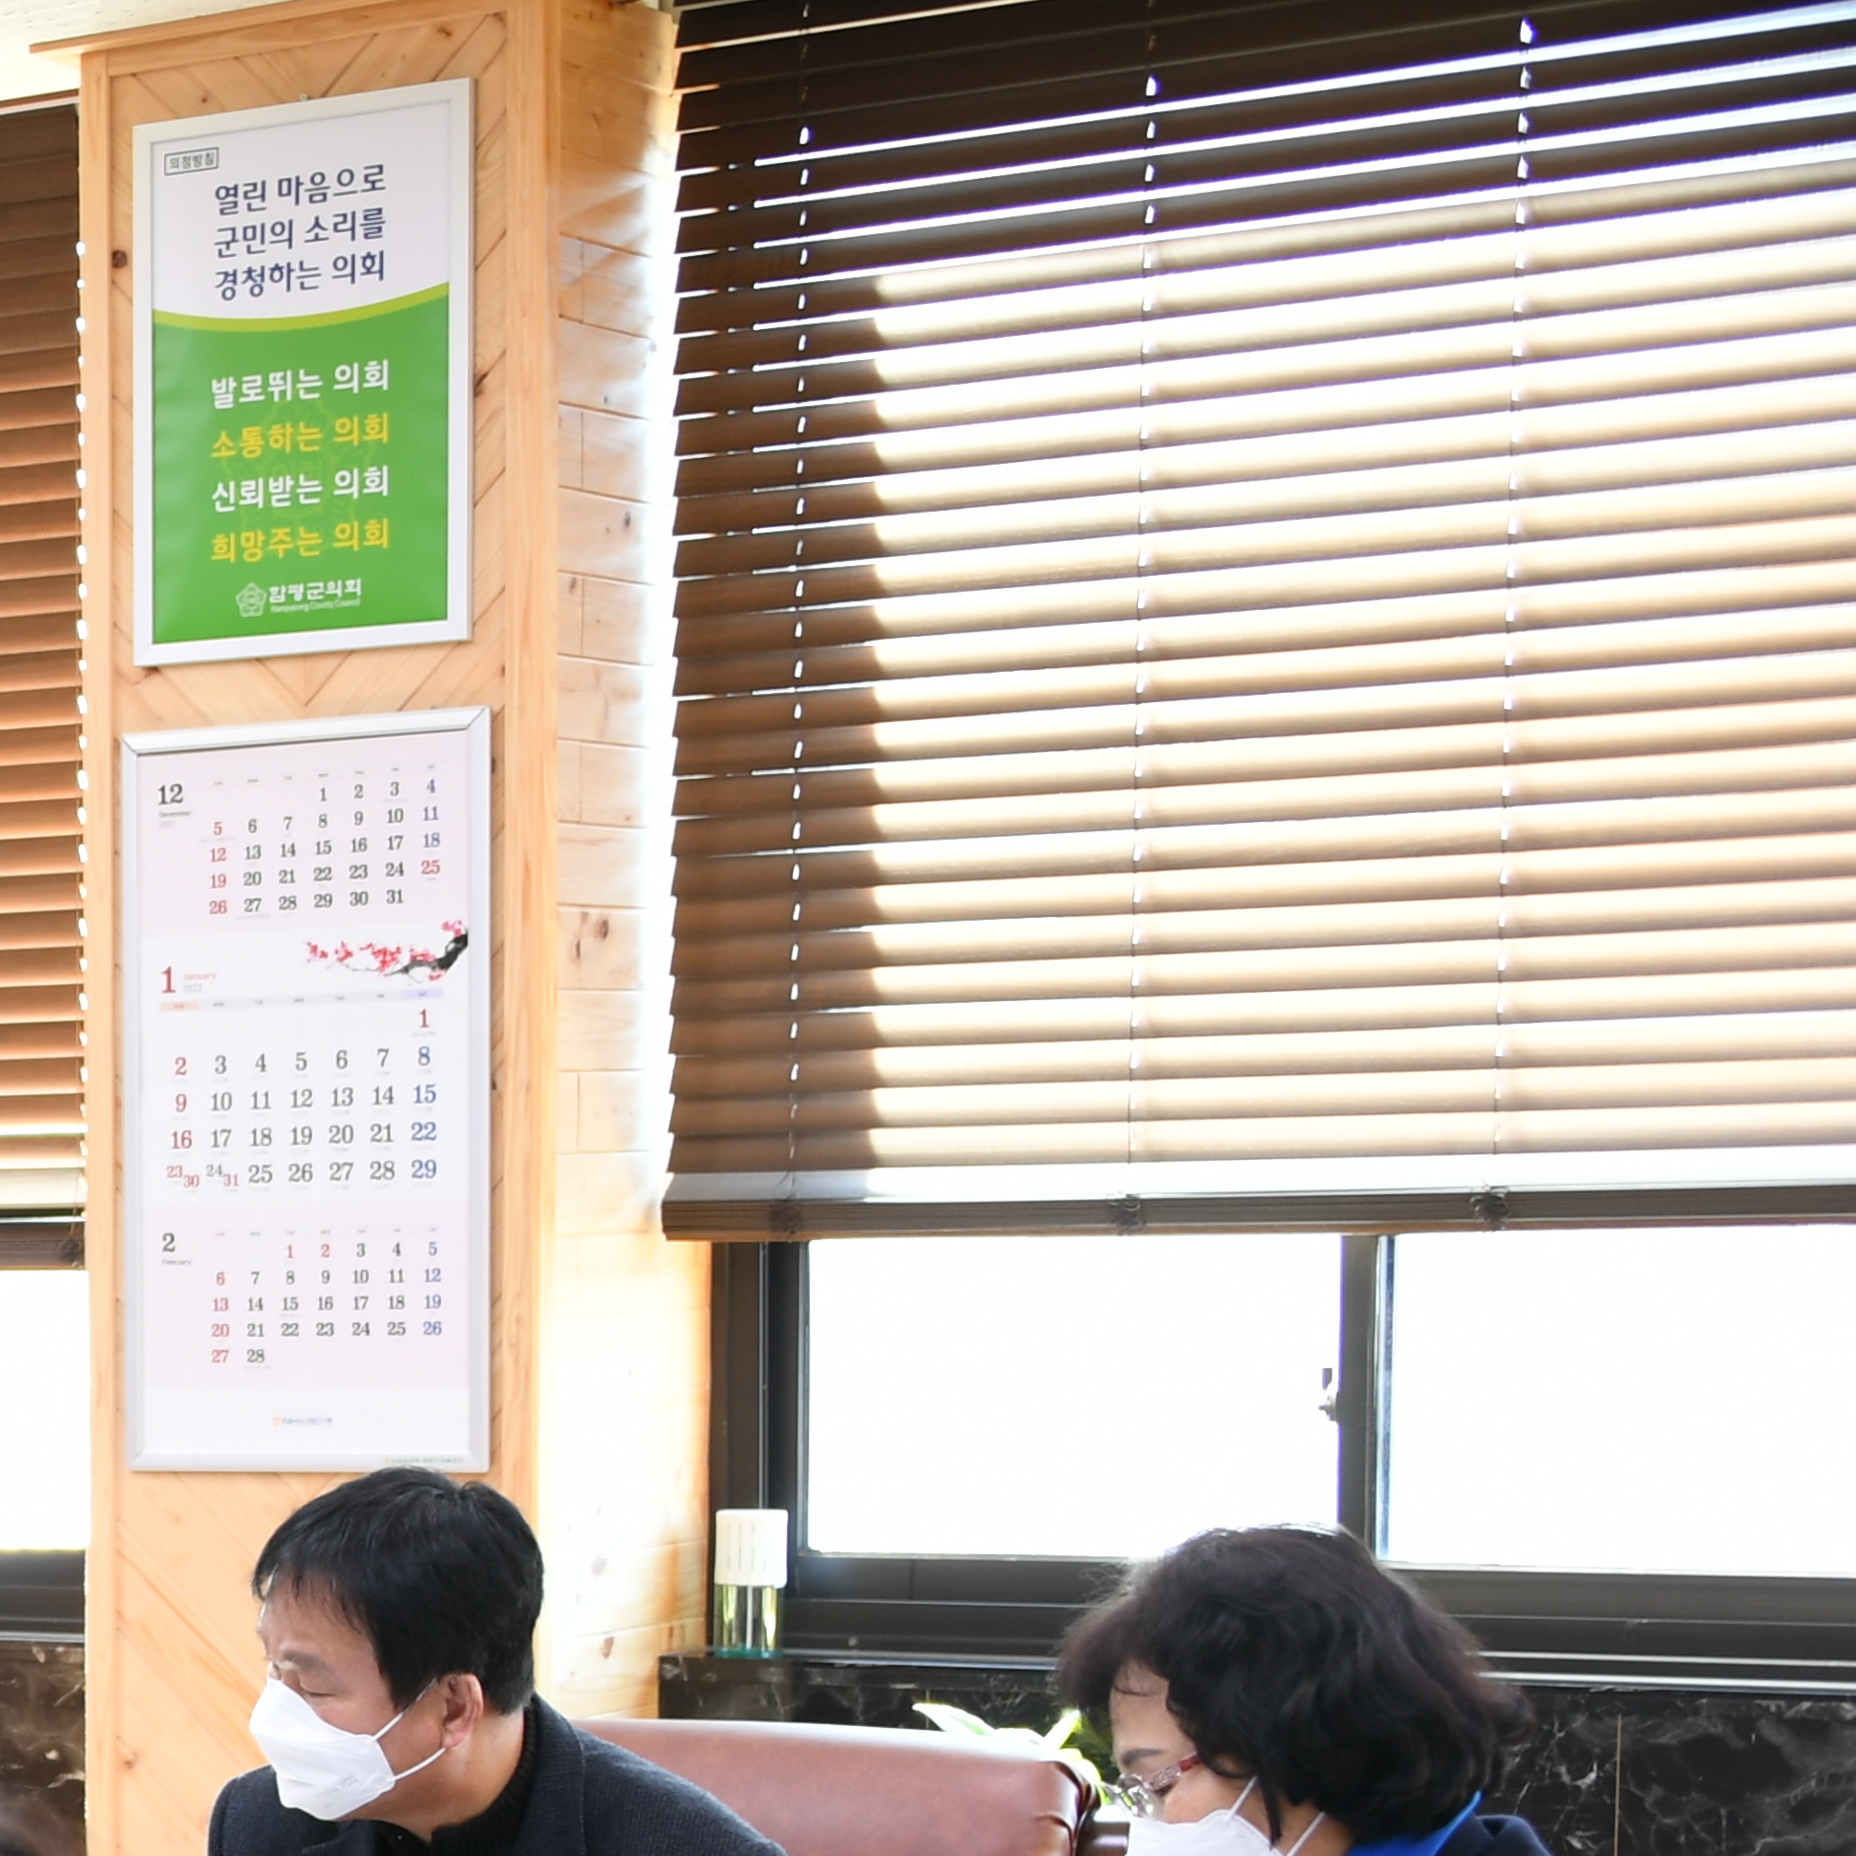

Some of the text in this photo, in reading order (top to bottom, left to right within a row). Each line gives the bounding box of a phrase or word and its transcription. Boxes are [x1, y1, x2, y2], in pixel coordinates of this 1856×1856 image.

[168, 152, 216, 170] 의정방침
[214, 163, 386, 216] 열린 마음으로
[214, 206, 386, 259] 군민의 소리를
[214, 250, 385, 301] 경청하는 의회
[211, 359, 390, 409] 발로뛰는 의회
[211, 412, 390, 459] 소통하는 의회
[212, 465, 389, 513] 신뢰받는 의회
[211, 518, 390, 563] 희망주는 의회
[269, 578, 361, 604] 함평군의회
[158, 783, 184, 806] 12
[319, 778, 436, 802] 1 2 3 4
[213, 805, 439, 836] 5 6 7 8 9 10 11
[210, 832, 441, 863] 12 13 14 15 16 17 18
[210, 859, 441, 889] 19 20 21 22 23 24 25
[208, 888, 404, 915] 26 27 28 29 30 31
[162, 966, 176, 994] 1
[419, 1008, 430, 1029] 1
[174, 1046, 431, 1076] 2 3 4 5 6 7 8
[175, 1083, 437, 1113] 9 10 11 12 13 14 15
[172, 1121, 437, 1150] 16 17 18 19 20 21 22
[167, 1159, 438, 1184] 23 24 25 26 27 28 29
[184, 1174, 238, 1187] 30 31
[162, 1232, 176, 1253] 2
[286, 1241, 438, 1259] 1 2 3 4 5
[215, 1267, 442, 1286] 6 7 8 9 10 11 12
[213, 1294, 442, 1313] 13 14 15 16 17 18 19
[211, 1320, 443, 1338] 20 21 22 23 24 25 26
[211, 1348, 266, 1364] 27 28
